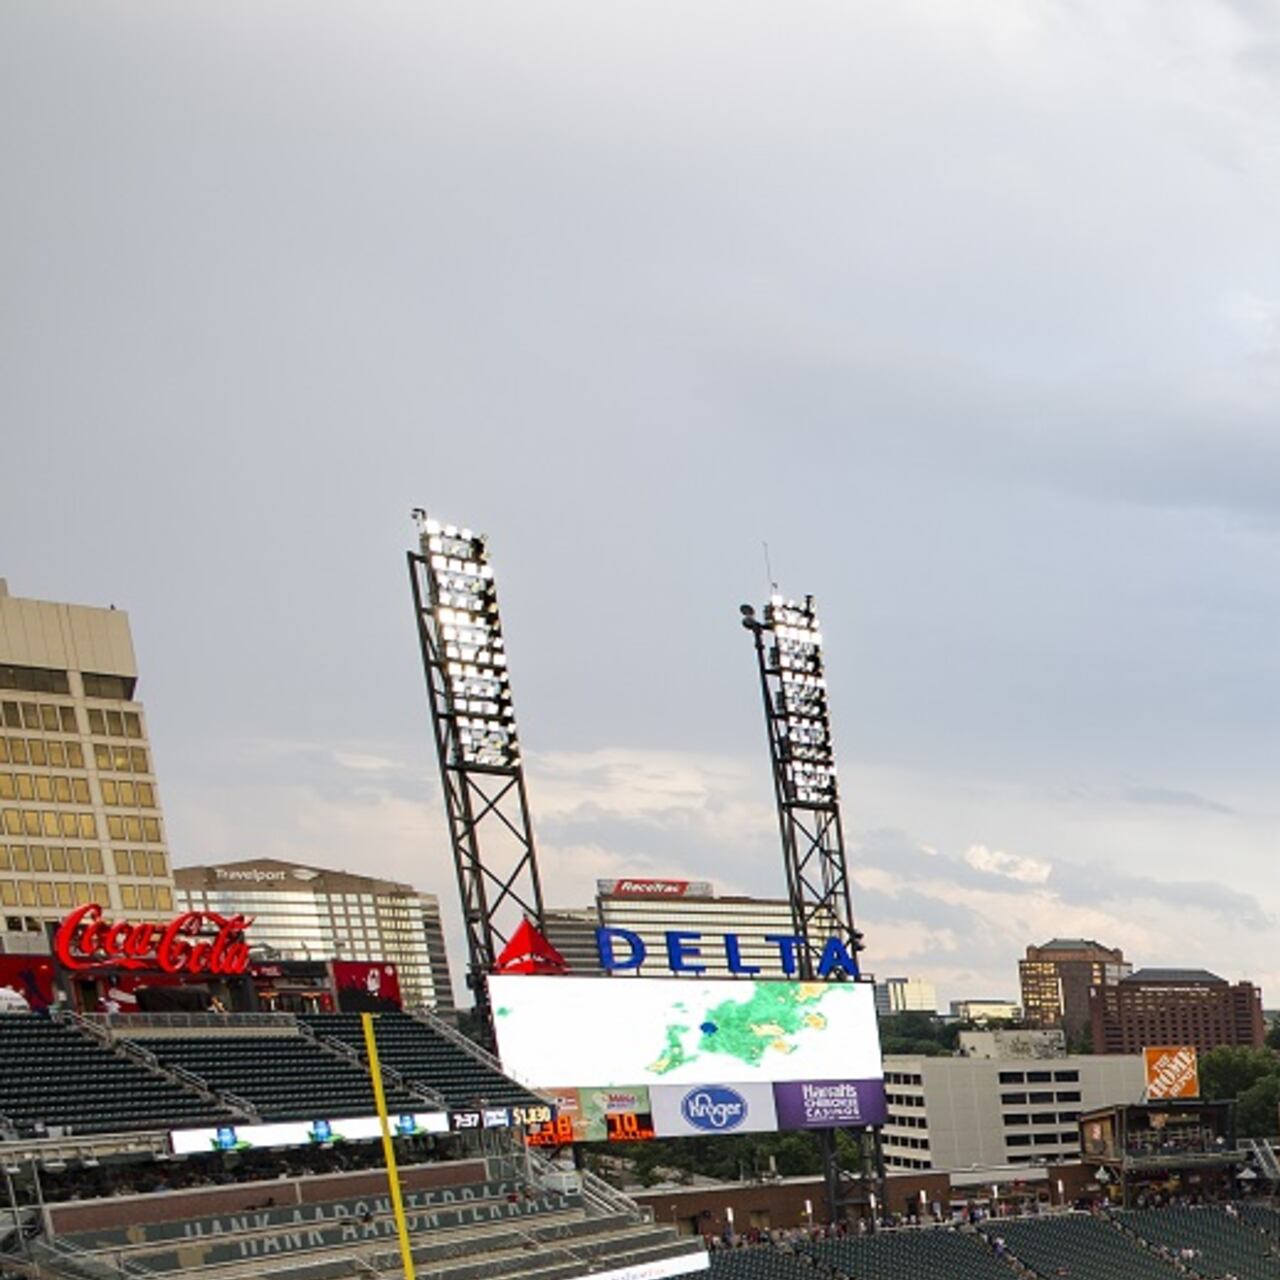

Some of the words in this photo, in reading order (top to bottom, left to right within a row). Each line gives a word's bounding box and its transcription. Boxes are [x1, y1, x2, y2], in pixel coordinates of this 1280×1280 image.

[215, 868, 287, 882] Travelport
[620, 881, 681, 893] RaceTrac
[596, 927, 860, 977] DELTA
[1149, 1047, 1195, 1097] HOME
[689, 1093, 744, 1125] Kroger
